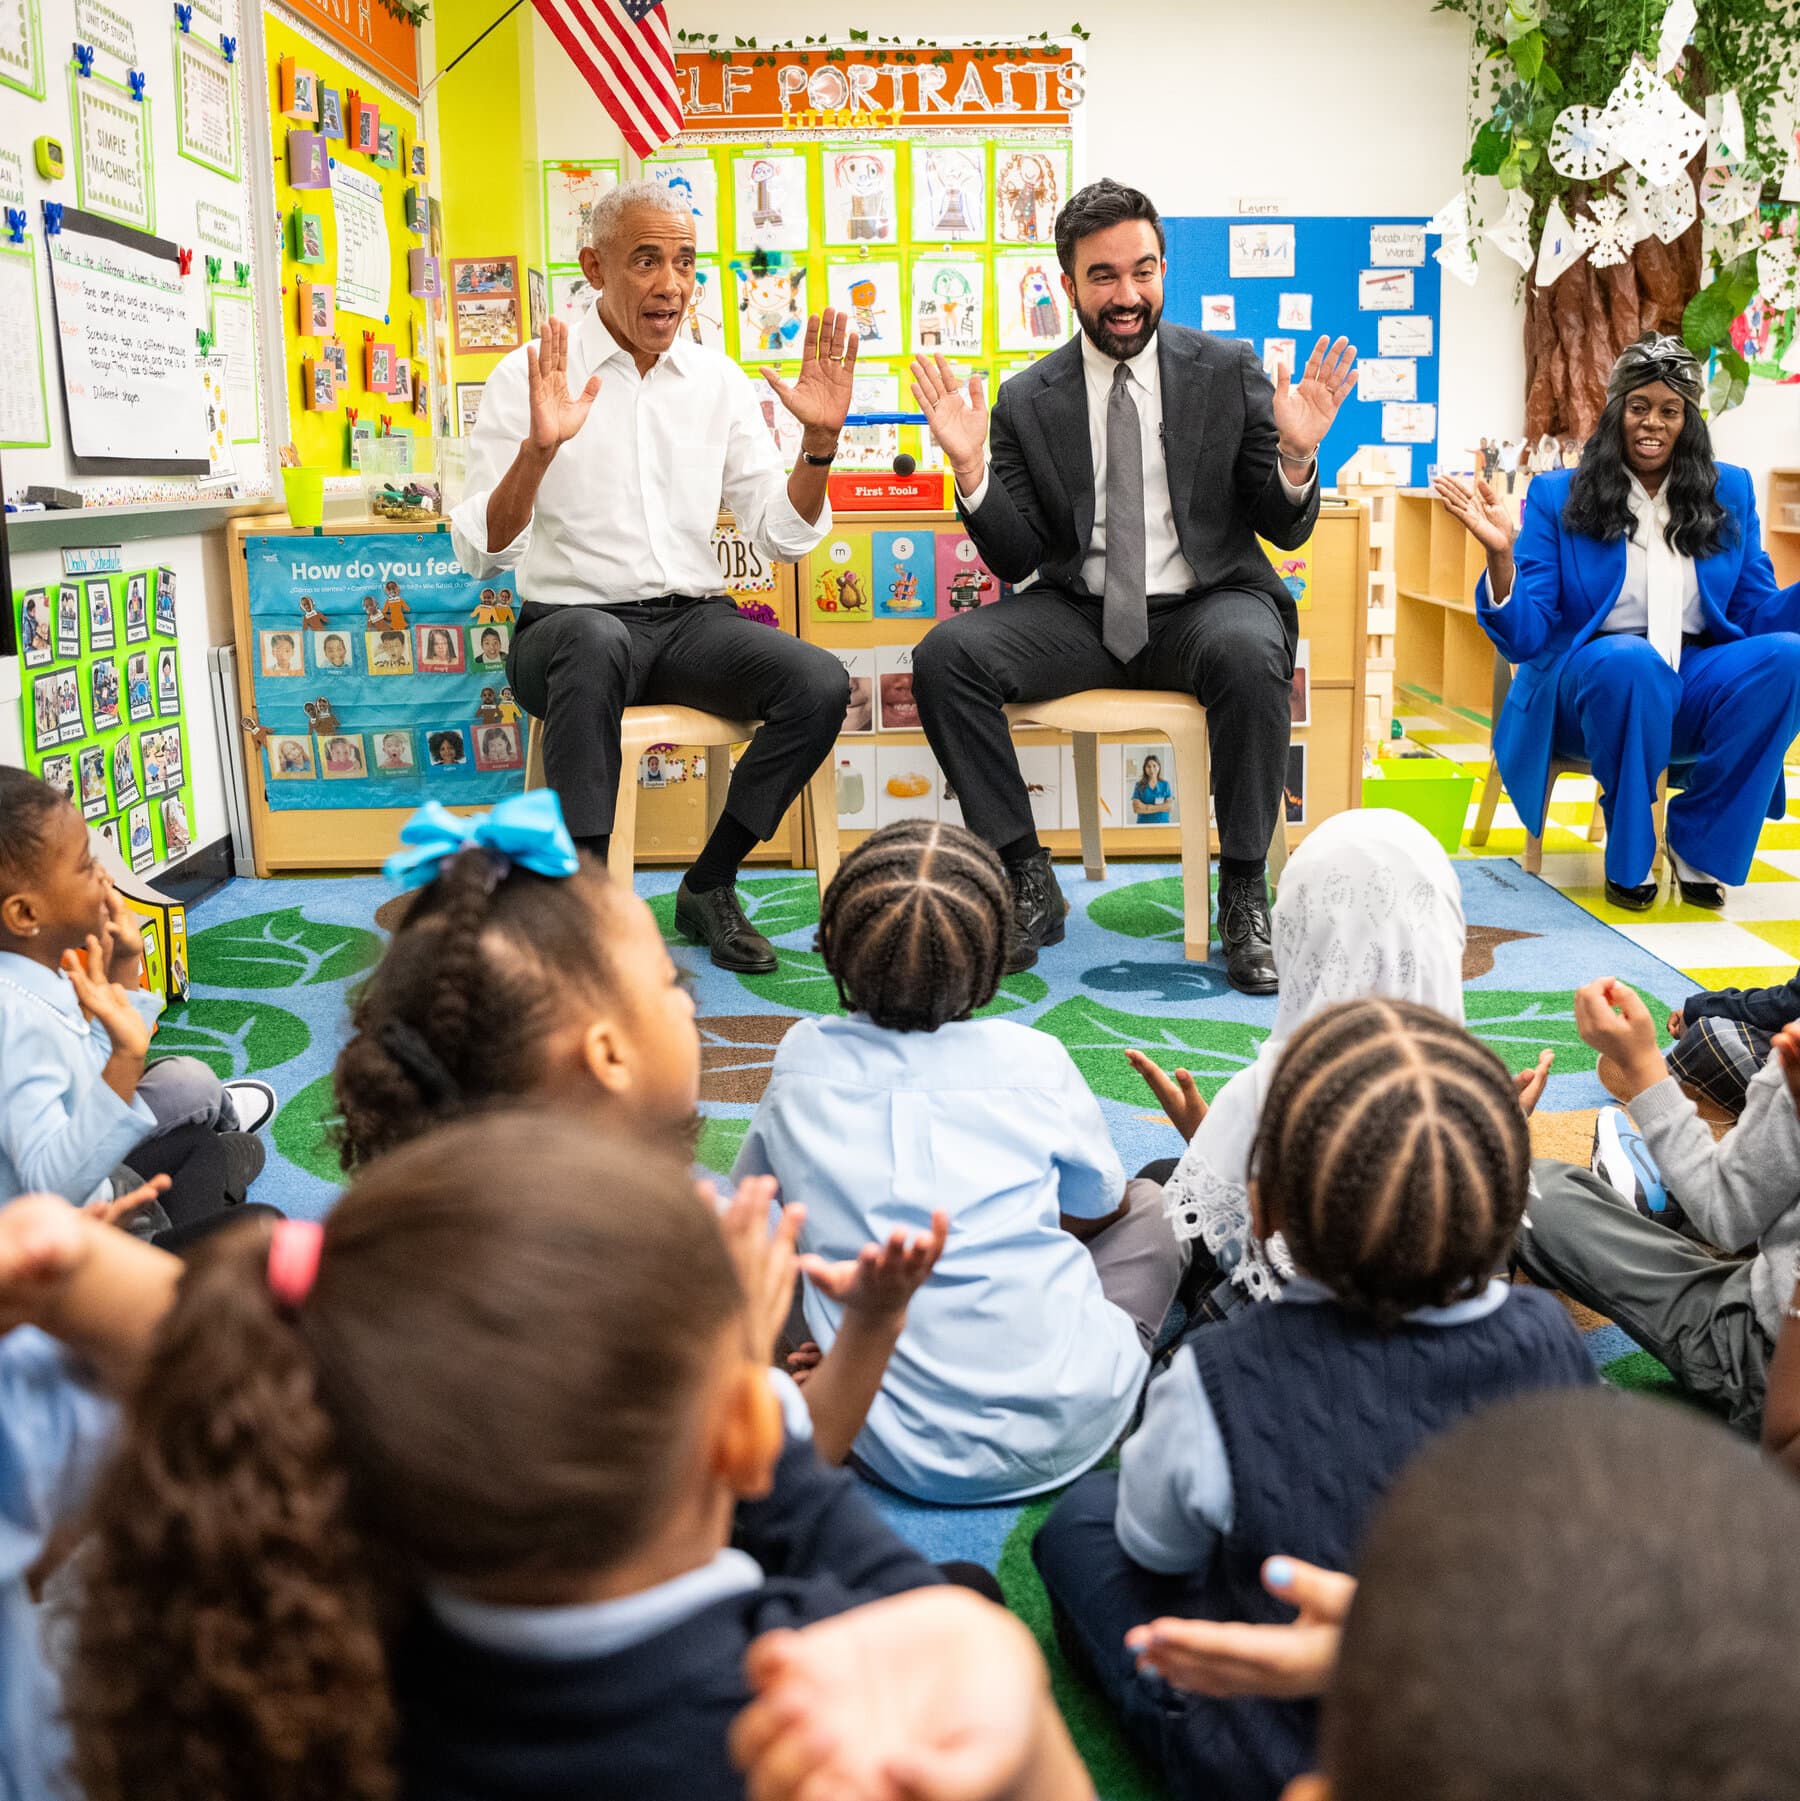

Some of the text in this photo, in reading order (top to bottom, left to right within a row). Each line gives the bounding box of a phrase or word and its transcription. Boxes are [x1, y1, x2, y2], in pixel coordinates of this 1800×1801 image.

[86, 12, 128, 45] UNIT OF STUDY
[675, 61, 1086, 113] LF PORTRAITS
[782, 108, 904, 130] LITERACY
[97, 129, 127, 156] SIMPLE
[91, 155, 137, 187] MACHINES
[1238, 199, 1279, 214] Levers
[1373, 232, 1422, 248] Vocabulary
[1385, 247, 1414, 258] Words
[855, 485, 918, 497] First Tools
[711, 540, 763, 578] OBS
[836, 548, 845, 557] m
[900, 545, 906, 553] s
[963, 544, 970, 557] t
[65, 549, 121, 573] Daily Schedule
[290, 561, 343, 580] How
[345, 559, 374, 578] do
[378, 562, 421, 582] you
